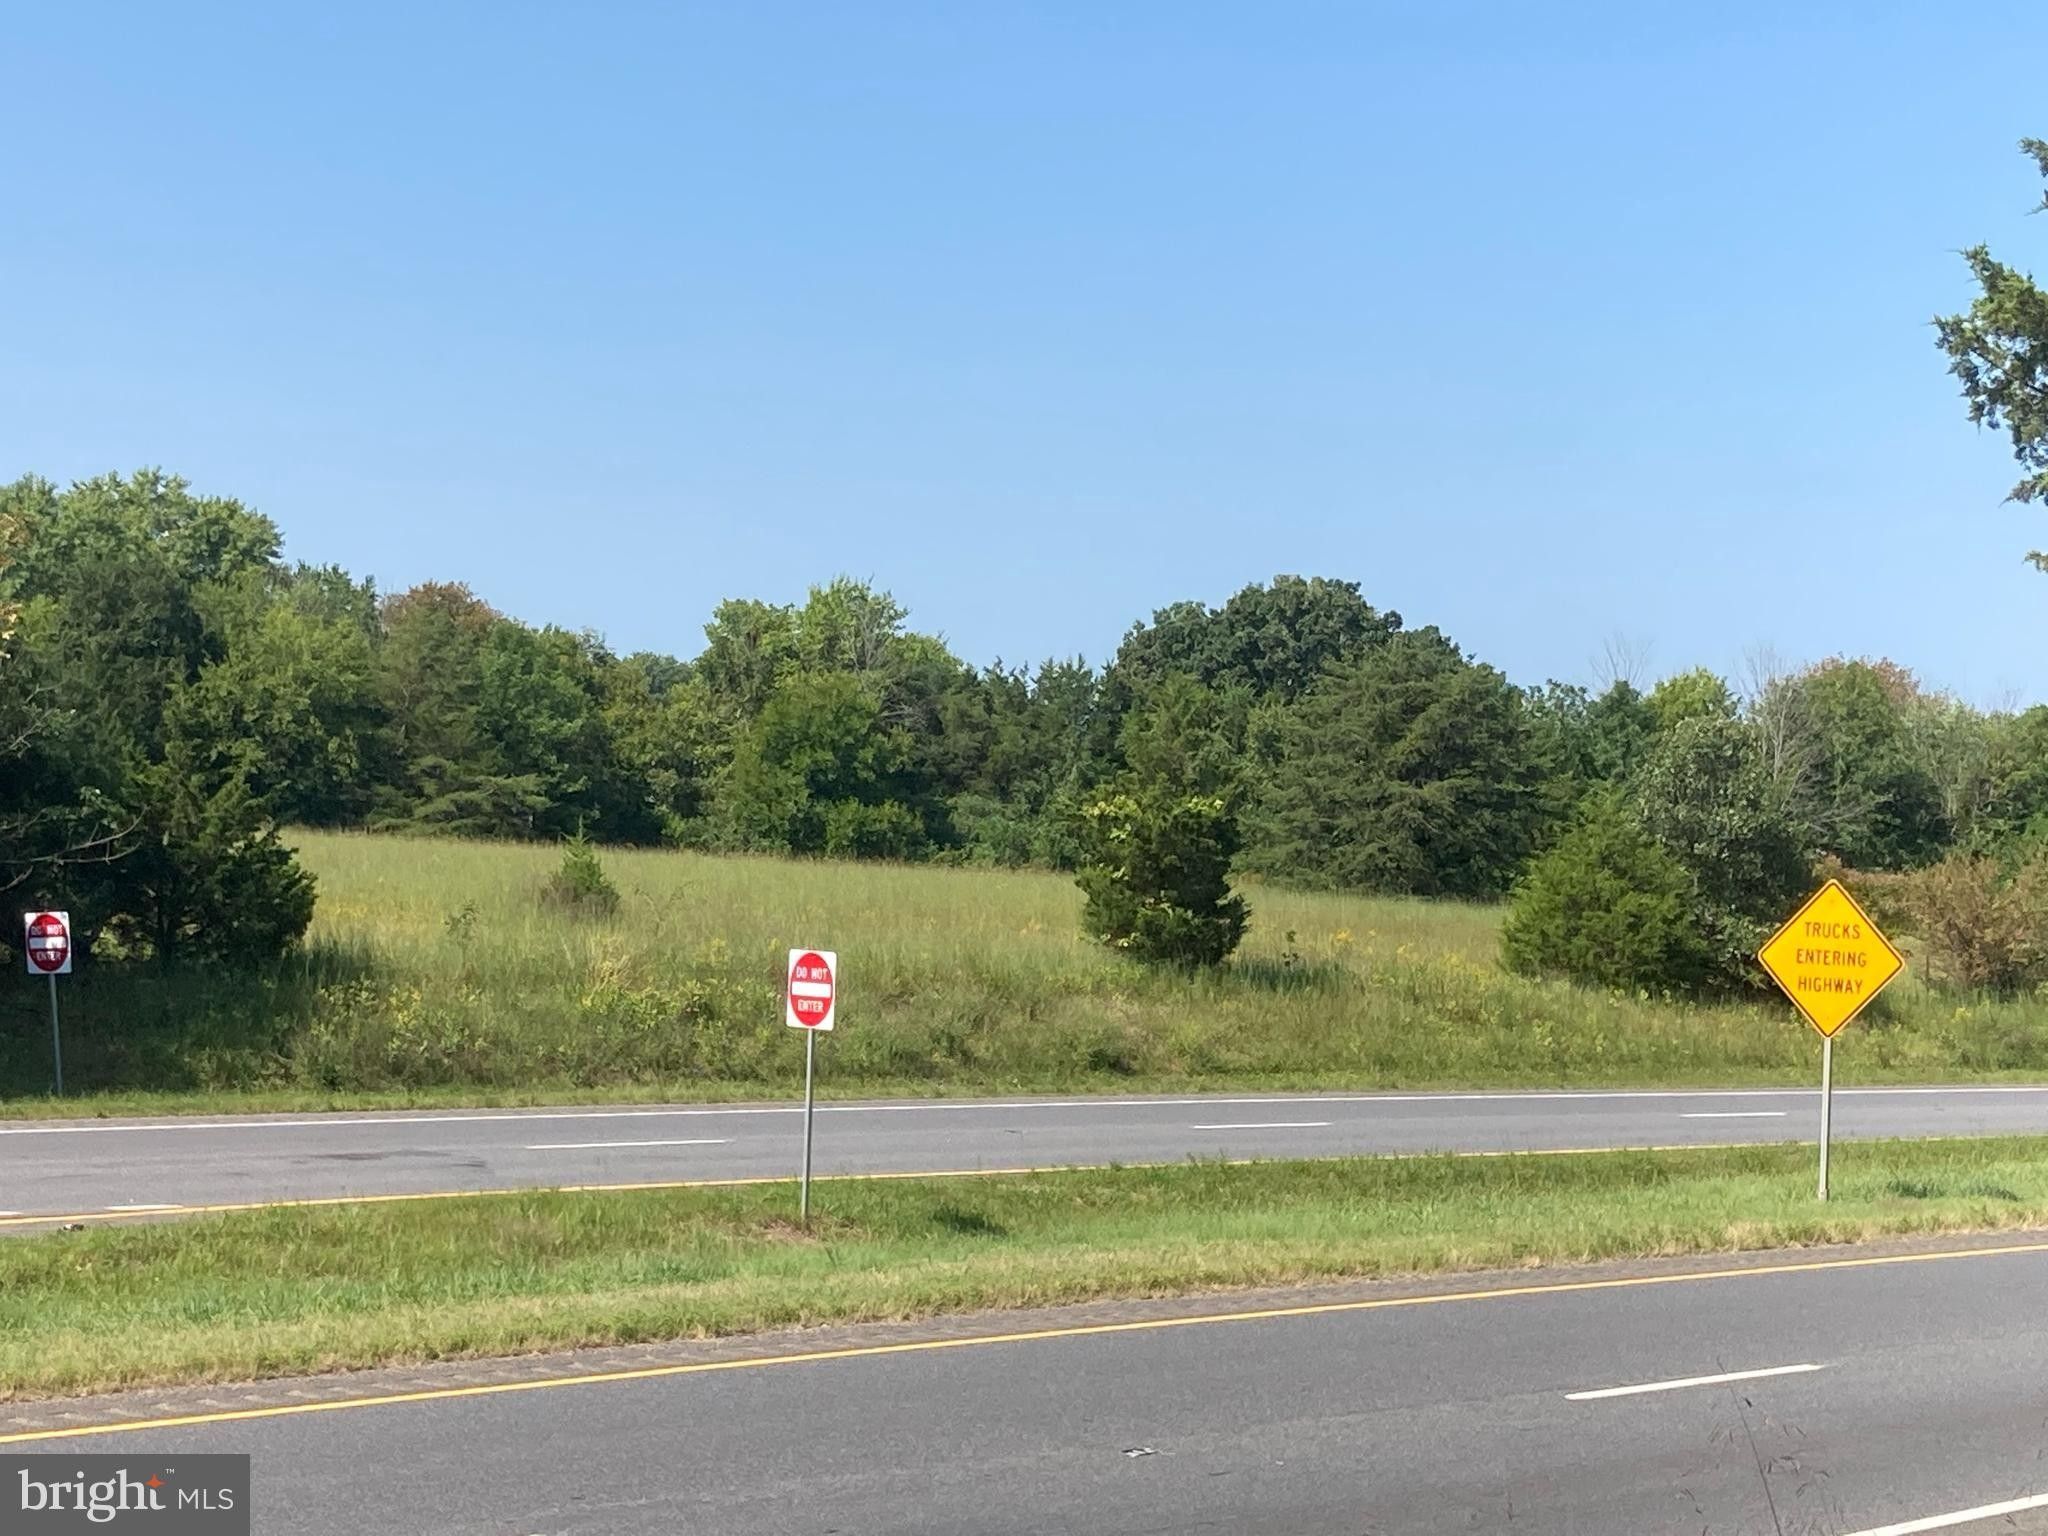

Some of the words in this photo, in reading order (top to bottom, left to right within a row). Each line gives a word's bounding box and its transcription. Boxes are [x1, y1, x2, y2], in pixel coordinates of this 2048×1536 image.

[1804, 921, 1861, 940] TRUCKS
[1796, 948, 1867, 968] ENTERING
[796, 966, 808, 979] DO
[810, 967, 828, 980] NOT
[1798, 976, 1863, 995] HIGHWAY
